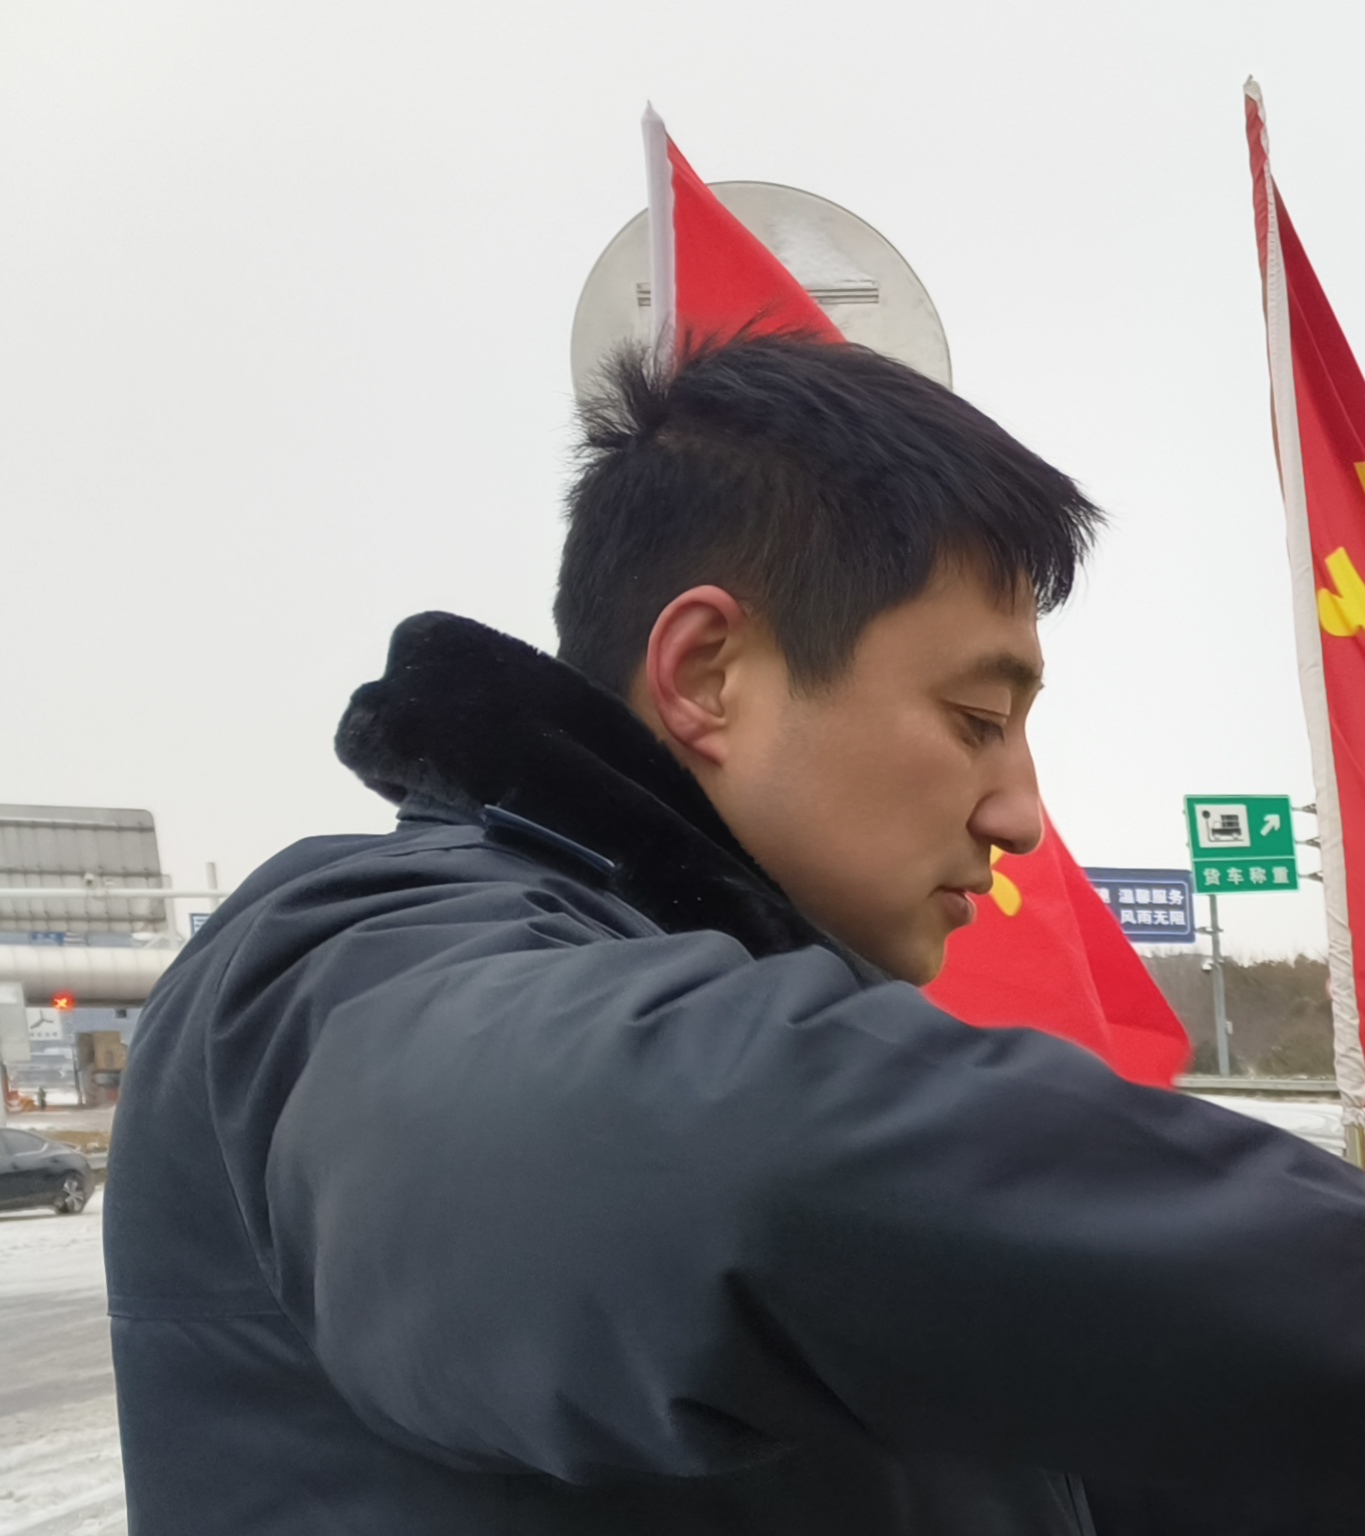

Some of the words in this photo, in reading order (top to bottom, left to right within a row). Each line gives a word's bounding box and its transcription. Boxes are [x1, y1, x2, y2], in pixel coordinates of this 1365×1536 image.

[1203, 866, 1290, 886] 货车称重
[1120, 909, 1186, 925] 风雨无阻
